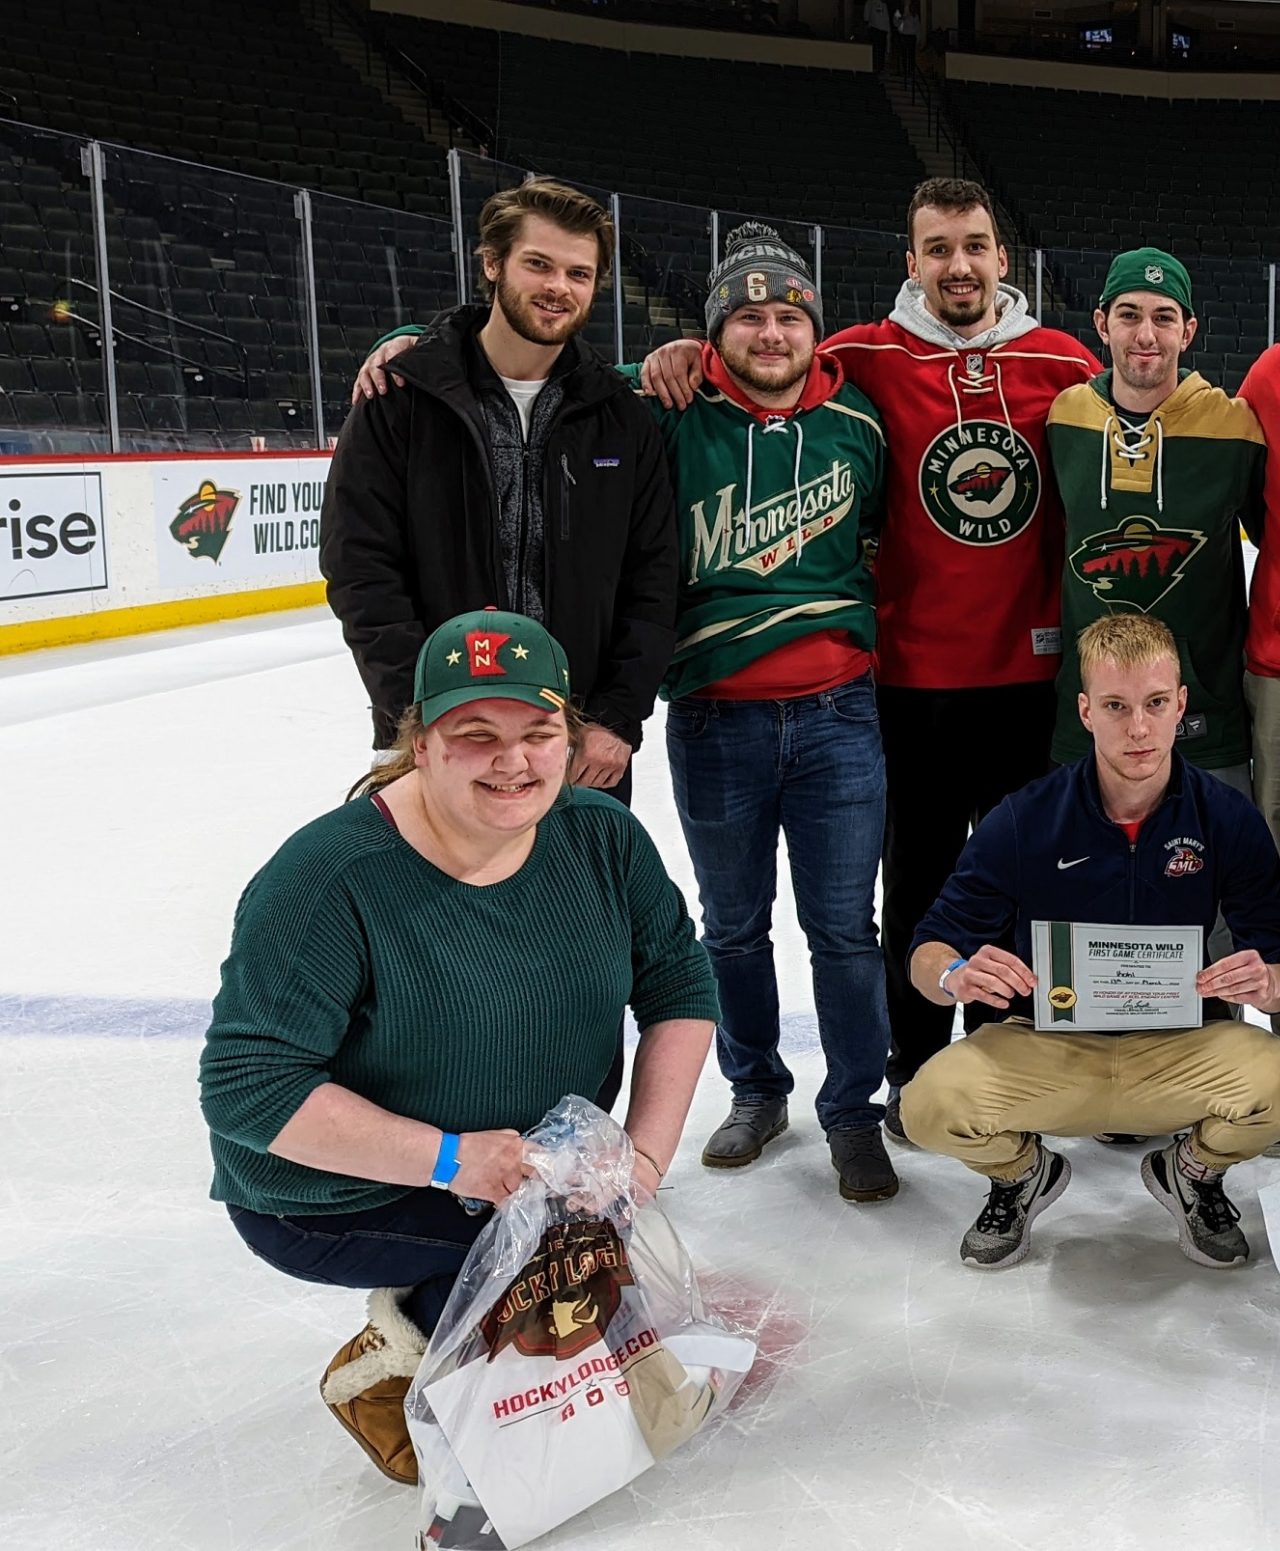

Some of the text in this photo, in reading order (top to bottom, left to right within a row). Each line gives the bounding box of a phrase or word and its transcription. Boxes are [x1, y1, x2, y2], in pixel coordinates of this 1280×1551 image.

[928, 427, 1030, 475] MINNESOTA
[250, 481, 328, 515] FIND YOU
[688, 460, 855, 586] Minnesota
[959, 518, 1011, 539] WILD
[758, 515, 834, 569] WILD
[1088, 941, 1184, 951] MINNESOTA WILD
[1088, 948, 1184, 959] FIRST GAME CERTIFICATE
